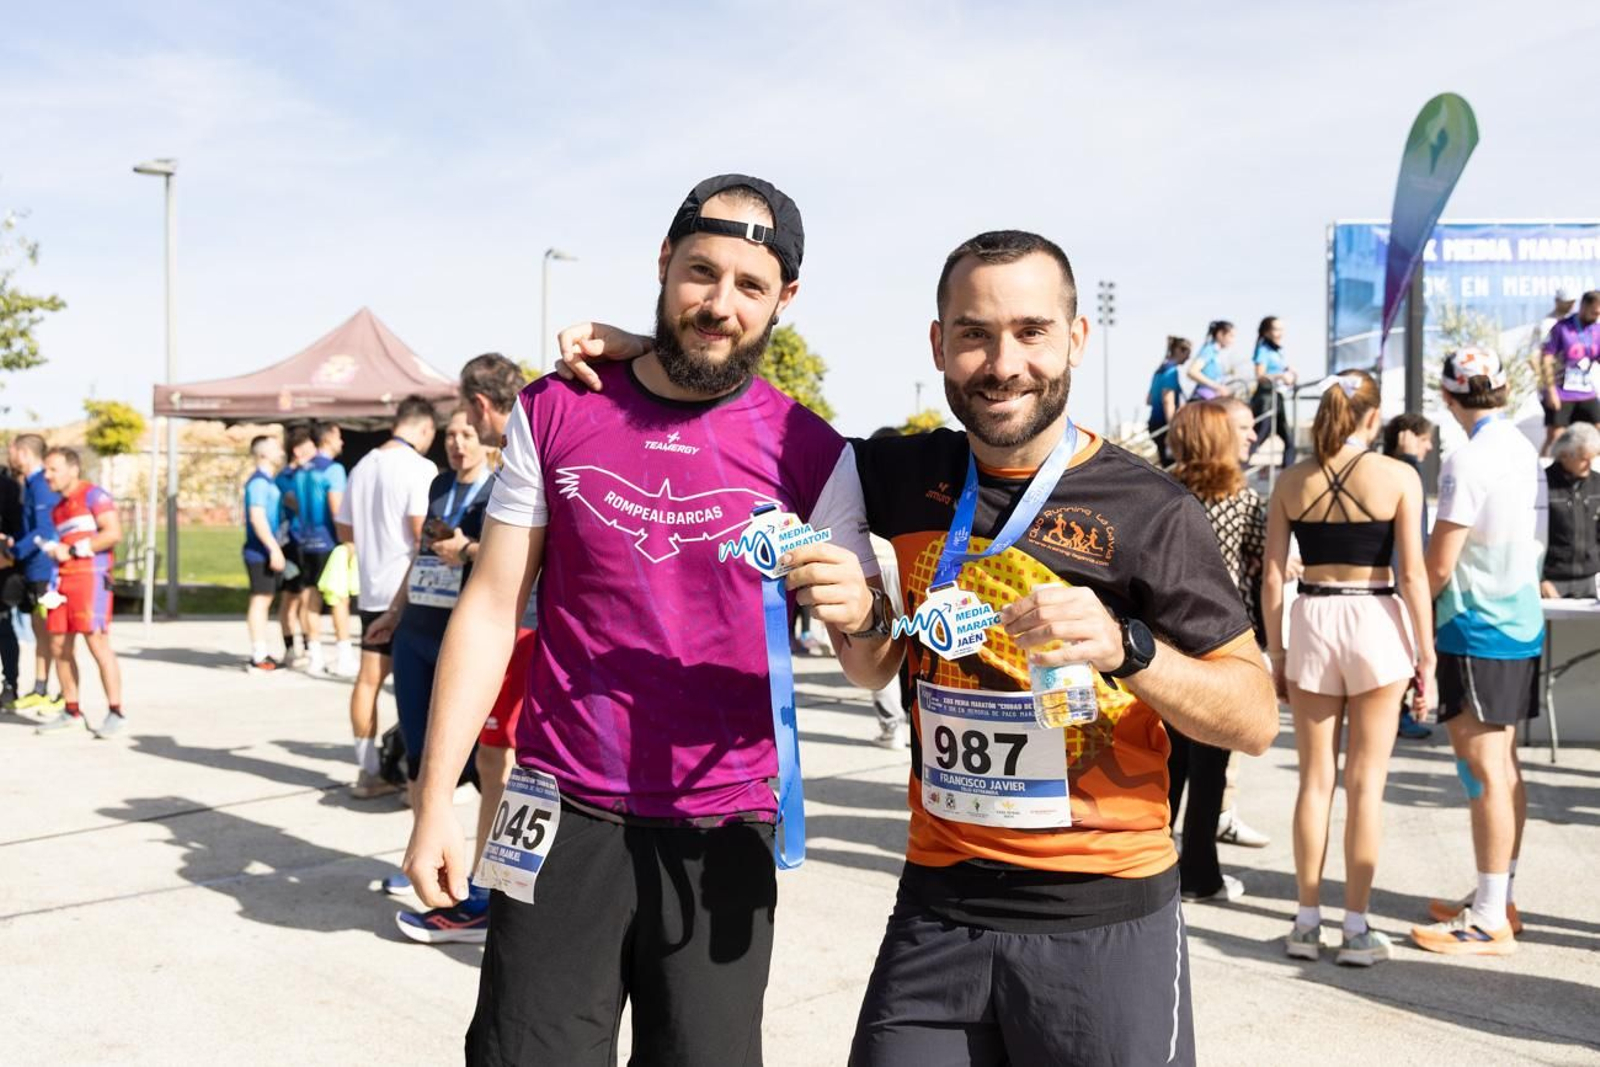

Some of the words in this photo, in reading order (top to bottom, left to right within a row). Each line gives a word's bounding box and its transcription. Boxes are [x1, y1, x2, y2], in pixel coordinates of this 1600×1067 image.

[1518, 238, 1600, 262] MARAT
[1461, 275, 1490, 297] EN
[644, 440, 700, 455] TEAMERGY
[604, 490, 723, 526] ROMPEALBARCAS
[778, 524, 812, 541] MEDIA
[955, 605, 991, 622] MEDIA
[957, 633, 984, 648] JAÉN
[934, 725, 1029, 776] 987
[939, 772, 987, 789] FRANCISCO
[989, 779, 1026, 792] JAVIER
[492, 800, 552, 850] 045
